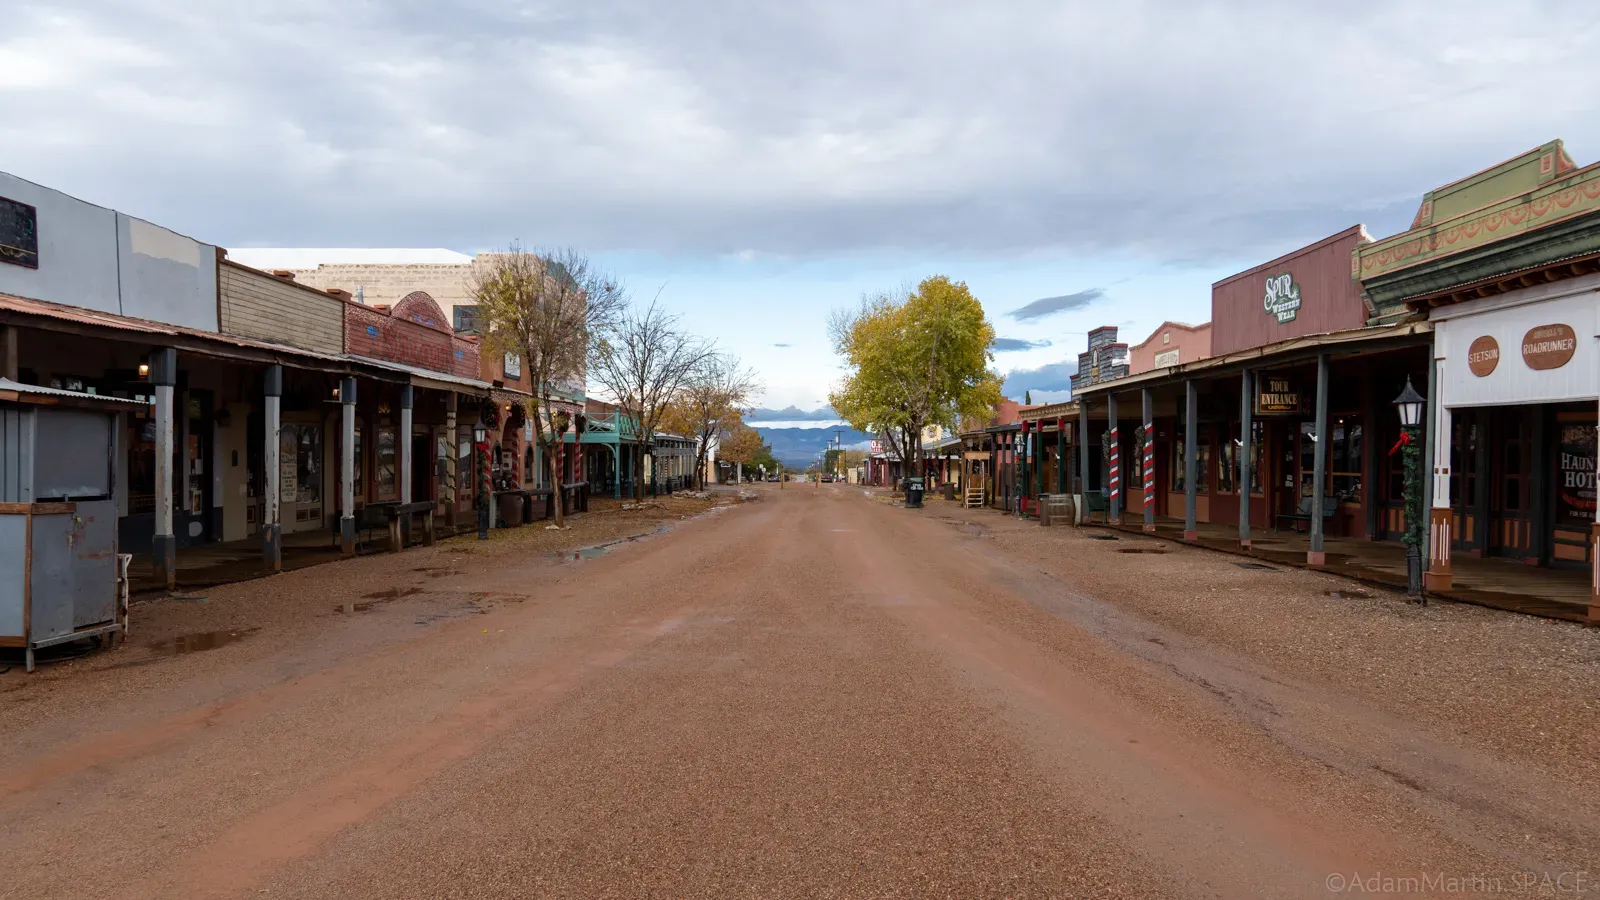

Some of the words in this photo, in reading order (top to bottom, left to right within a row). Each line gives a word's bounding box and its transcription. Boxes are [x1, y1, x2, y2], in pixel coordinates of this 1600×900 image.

[1272, 299, 1301, 314] WESTERN
[1277, 310, 1296, 321] WEAR
[1523, 338, 1573, 355] ROADRUNNER
[1469, 349, 1498, 364] STETSON
[1270, 381, 1289, 392] TOUR
[1261, 393, 1298, 405] ENTRANCE
[1561, 452, 1598, 470] HAUN
